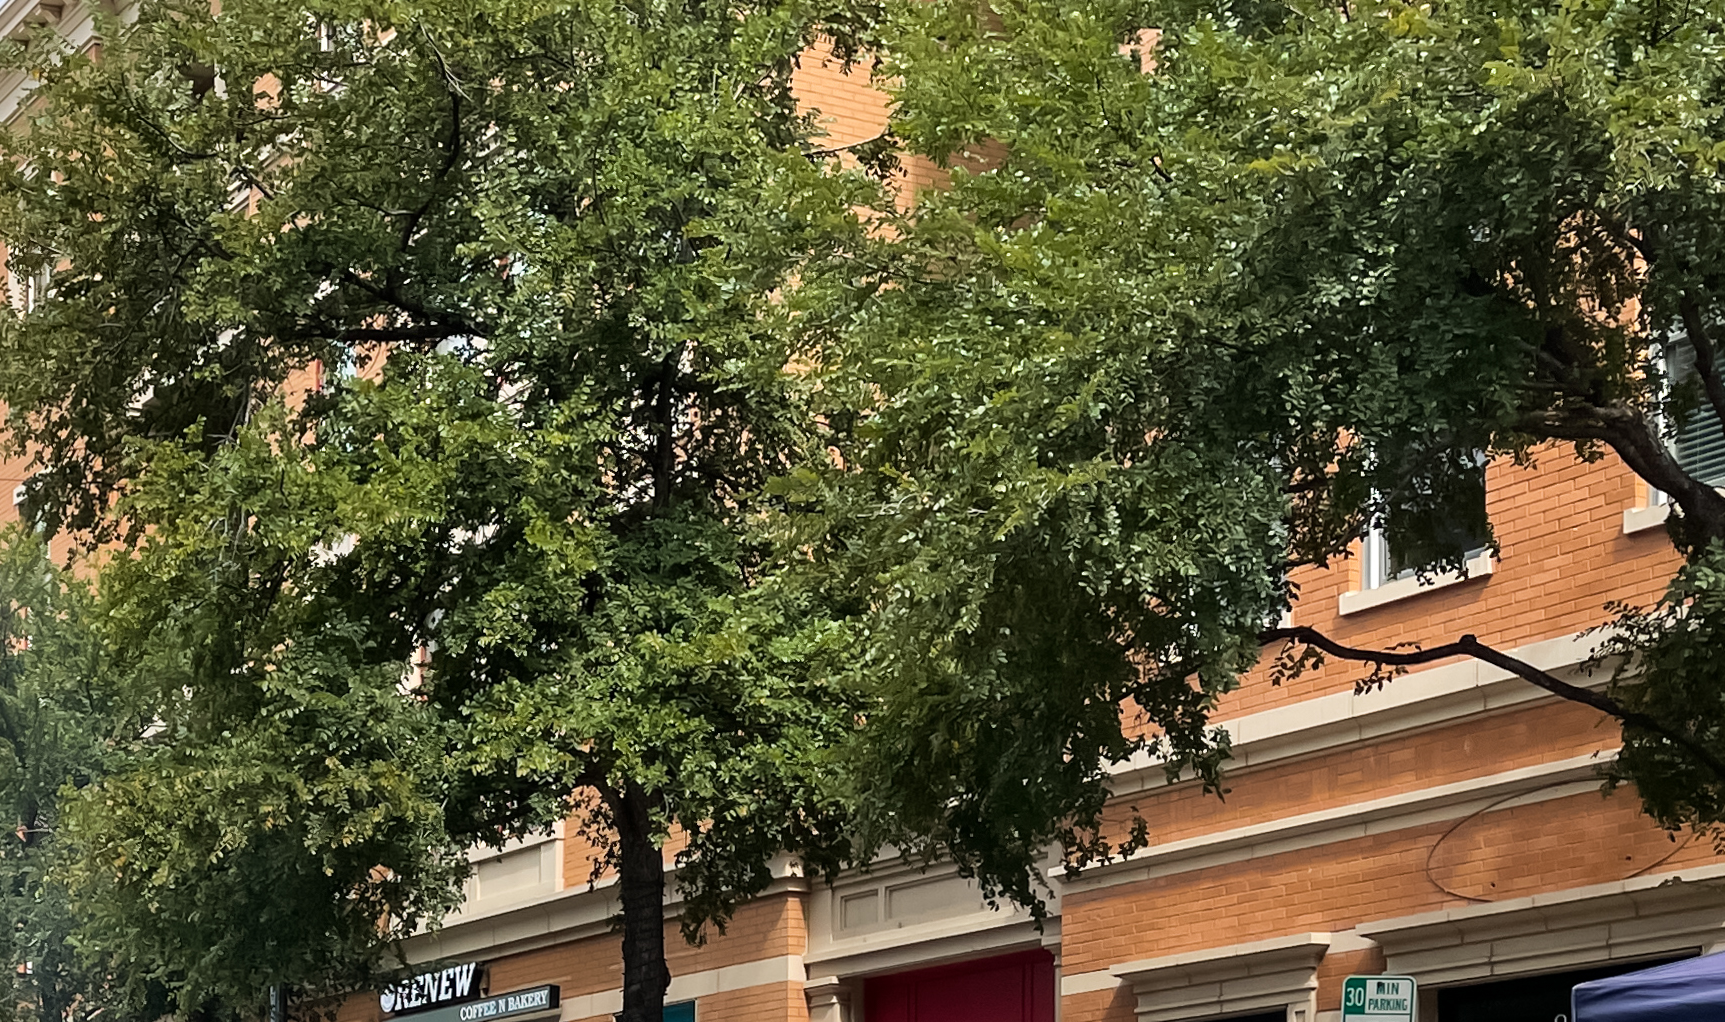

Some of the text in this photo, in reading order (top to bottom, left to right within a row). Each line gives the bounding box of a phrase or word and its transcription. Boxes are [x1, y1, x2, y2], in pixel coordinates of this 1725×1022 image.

[395, 962, 477, 1011] RENEW
[1376, 982, 1400, 995] MIN
[459, 989, 549, 1021] COFFEE N BAKERY
[1346, 987, 1365, 1007] 30
[1368, 998, 1408, 1011] PARKING
